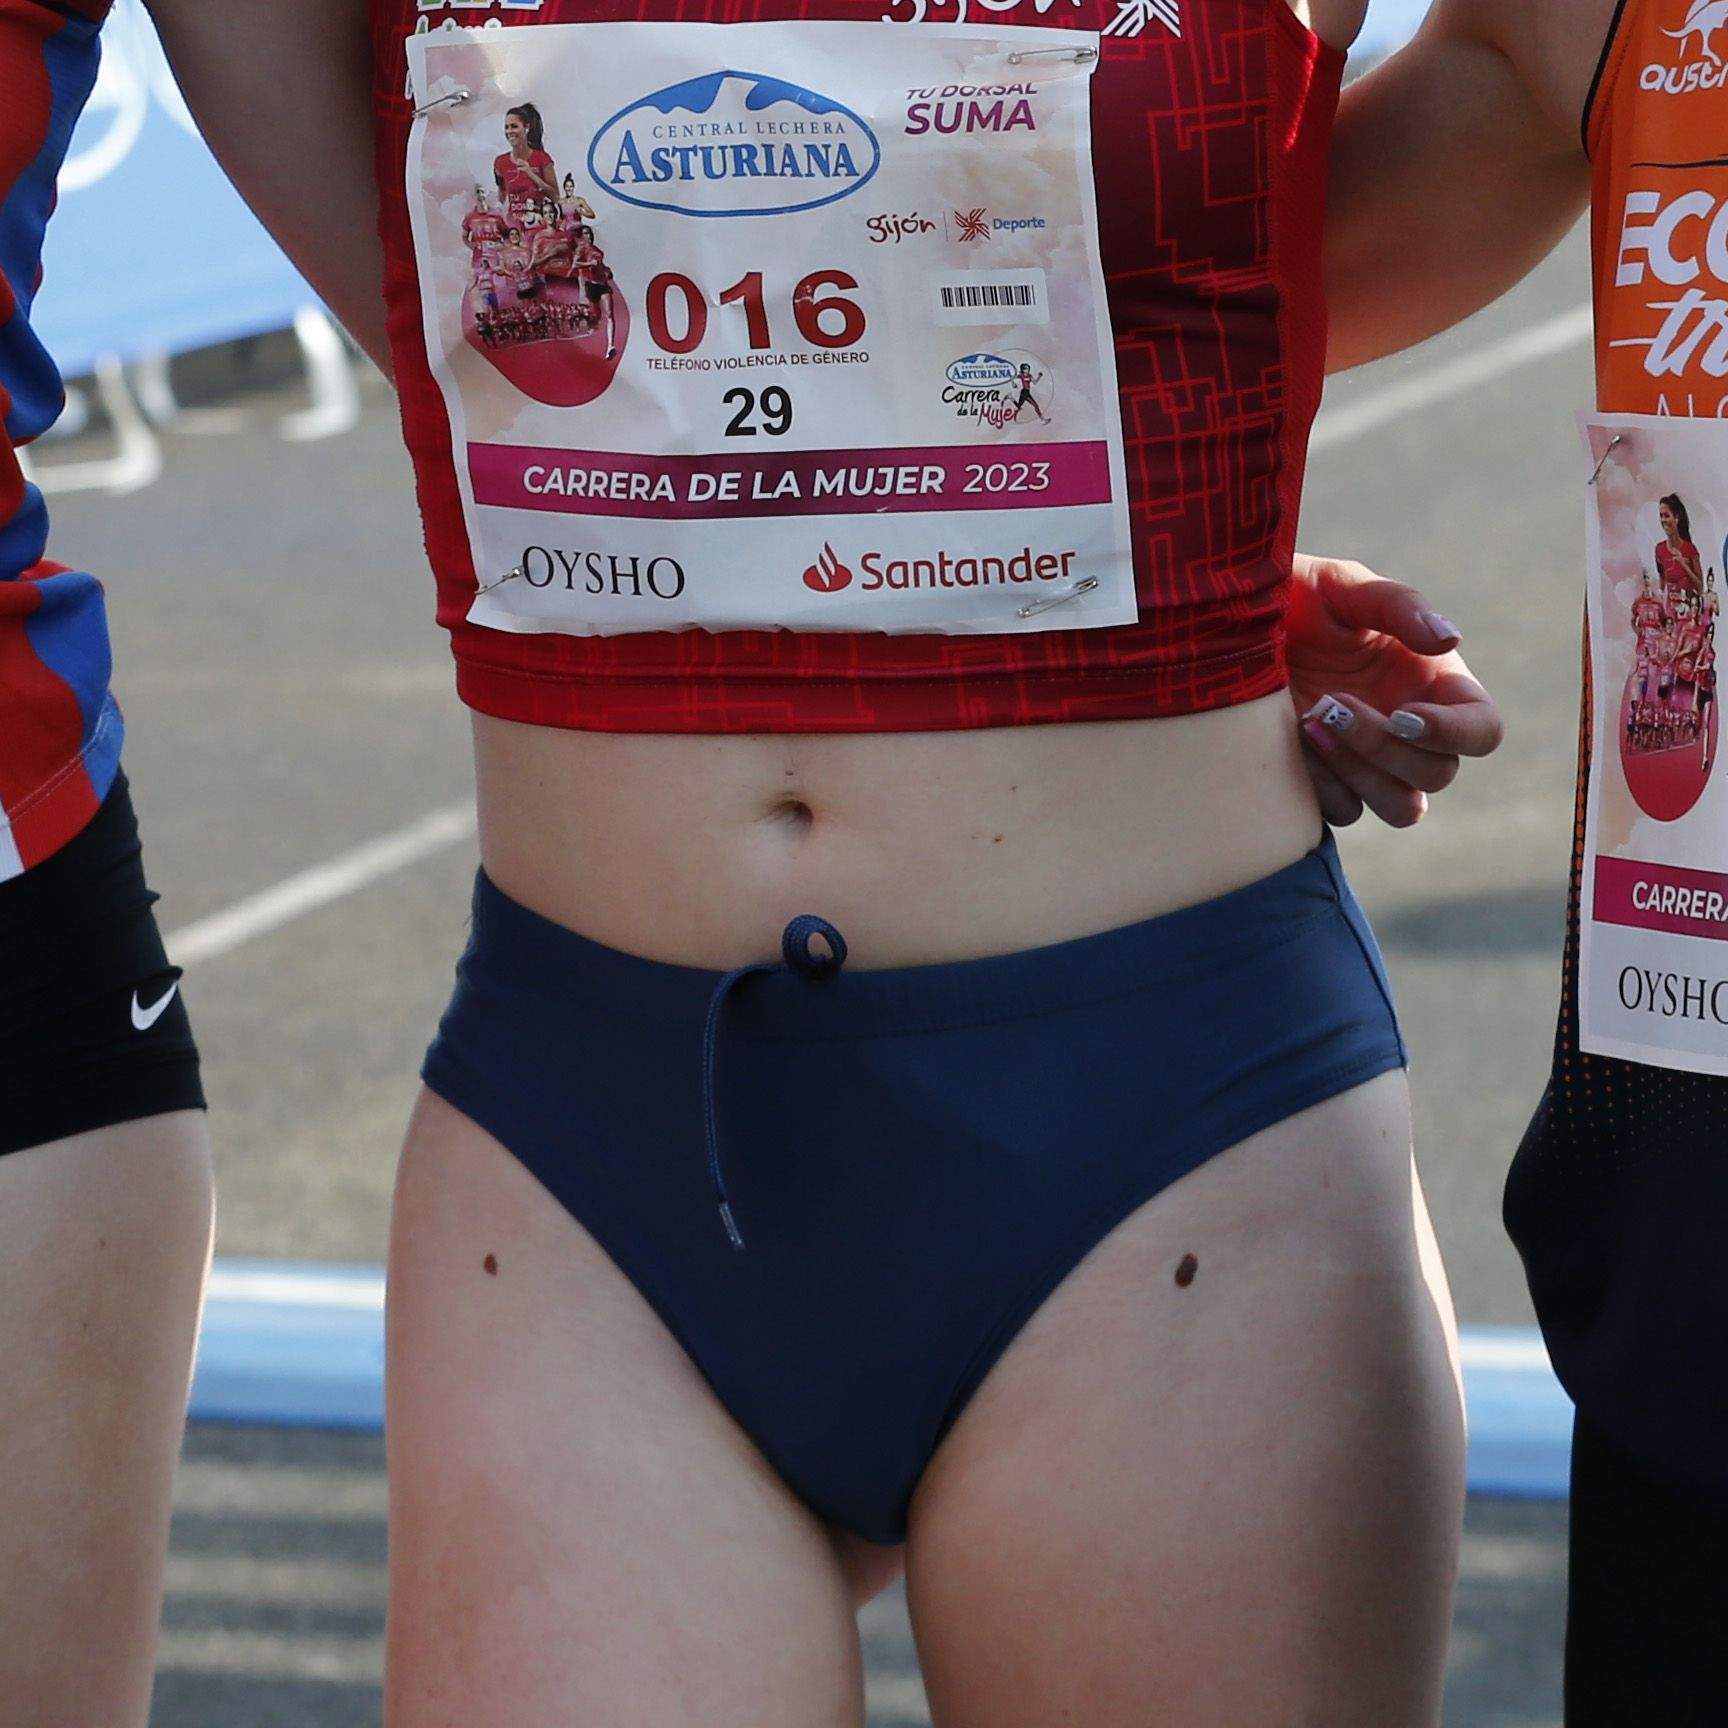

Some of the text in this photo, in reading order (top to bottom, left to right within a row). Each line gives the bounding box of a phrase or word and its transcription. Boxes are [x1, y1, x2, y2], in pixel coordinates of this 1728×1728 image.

[906, 82, 1038, 100] TU DORSAL
[653, 121, 845, 139] CENTRAL LECHERA
[904, 99, 1036, 135] SUMA
[611, 129, 860, 184] ASTURIANA
[866, 212, 1046, 243] gijón Deporte
[646, 269, 867, 355] 016
[647, 350, 870, 371] TELÉFONO VIOLENCIA DE GÉNERO
[952, 366, 1013, 380] ASTURIANA
[941, 385, 1001, 403] Carrera
[722, 386, 793, 437] 29
[977, 403, 1019, 429] Mujer
[522, 462, 1052, 502] CARRERA DE LA MUJER 2023
[522, 545, 686, 600] OYSHO
[861, 547, 1076, 591] Santander
